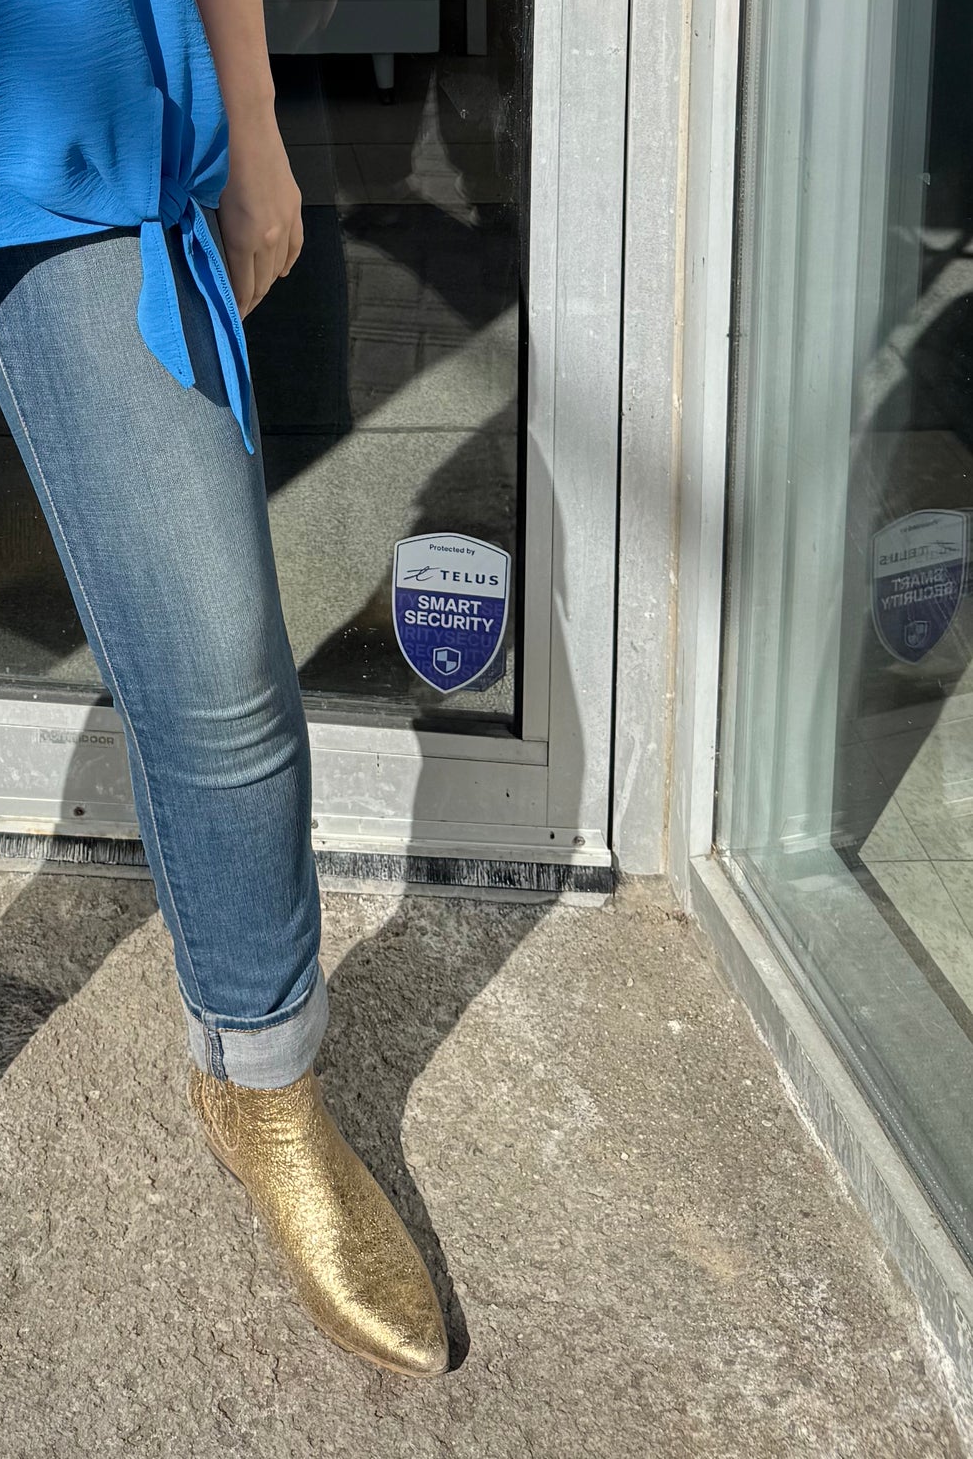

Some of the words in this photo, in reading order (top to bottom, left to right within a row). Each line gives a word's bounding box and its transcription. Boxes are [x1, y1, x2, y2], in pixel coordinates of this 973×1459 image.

[429, 543, 464, 554] Protected
[466, 548, 476, 556] by
[440, 569, 499, 586] TELUS
[417, 594, 482, 615] SMART
[404, 609, 495, 633] SECURITY
